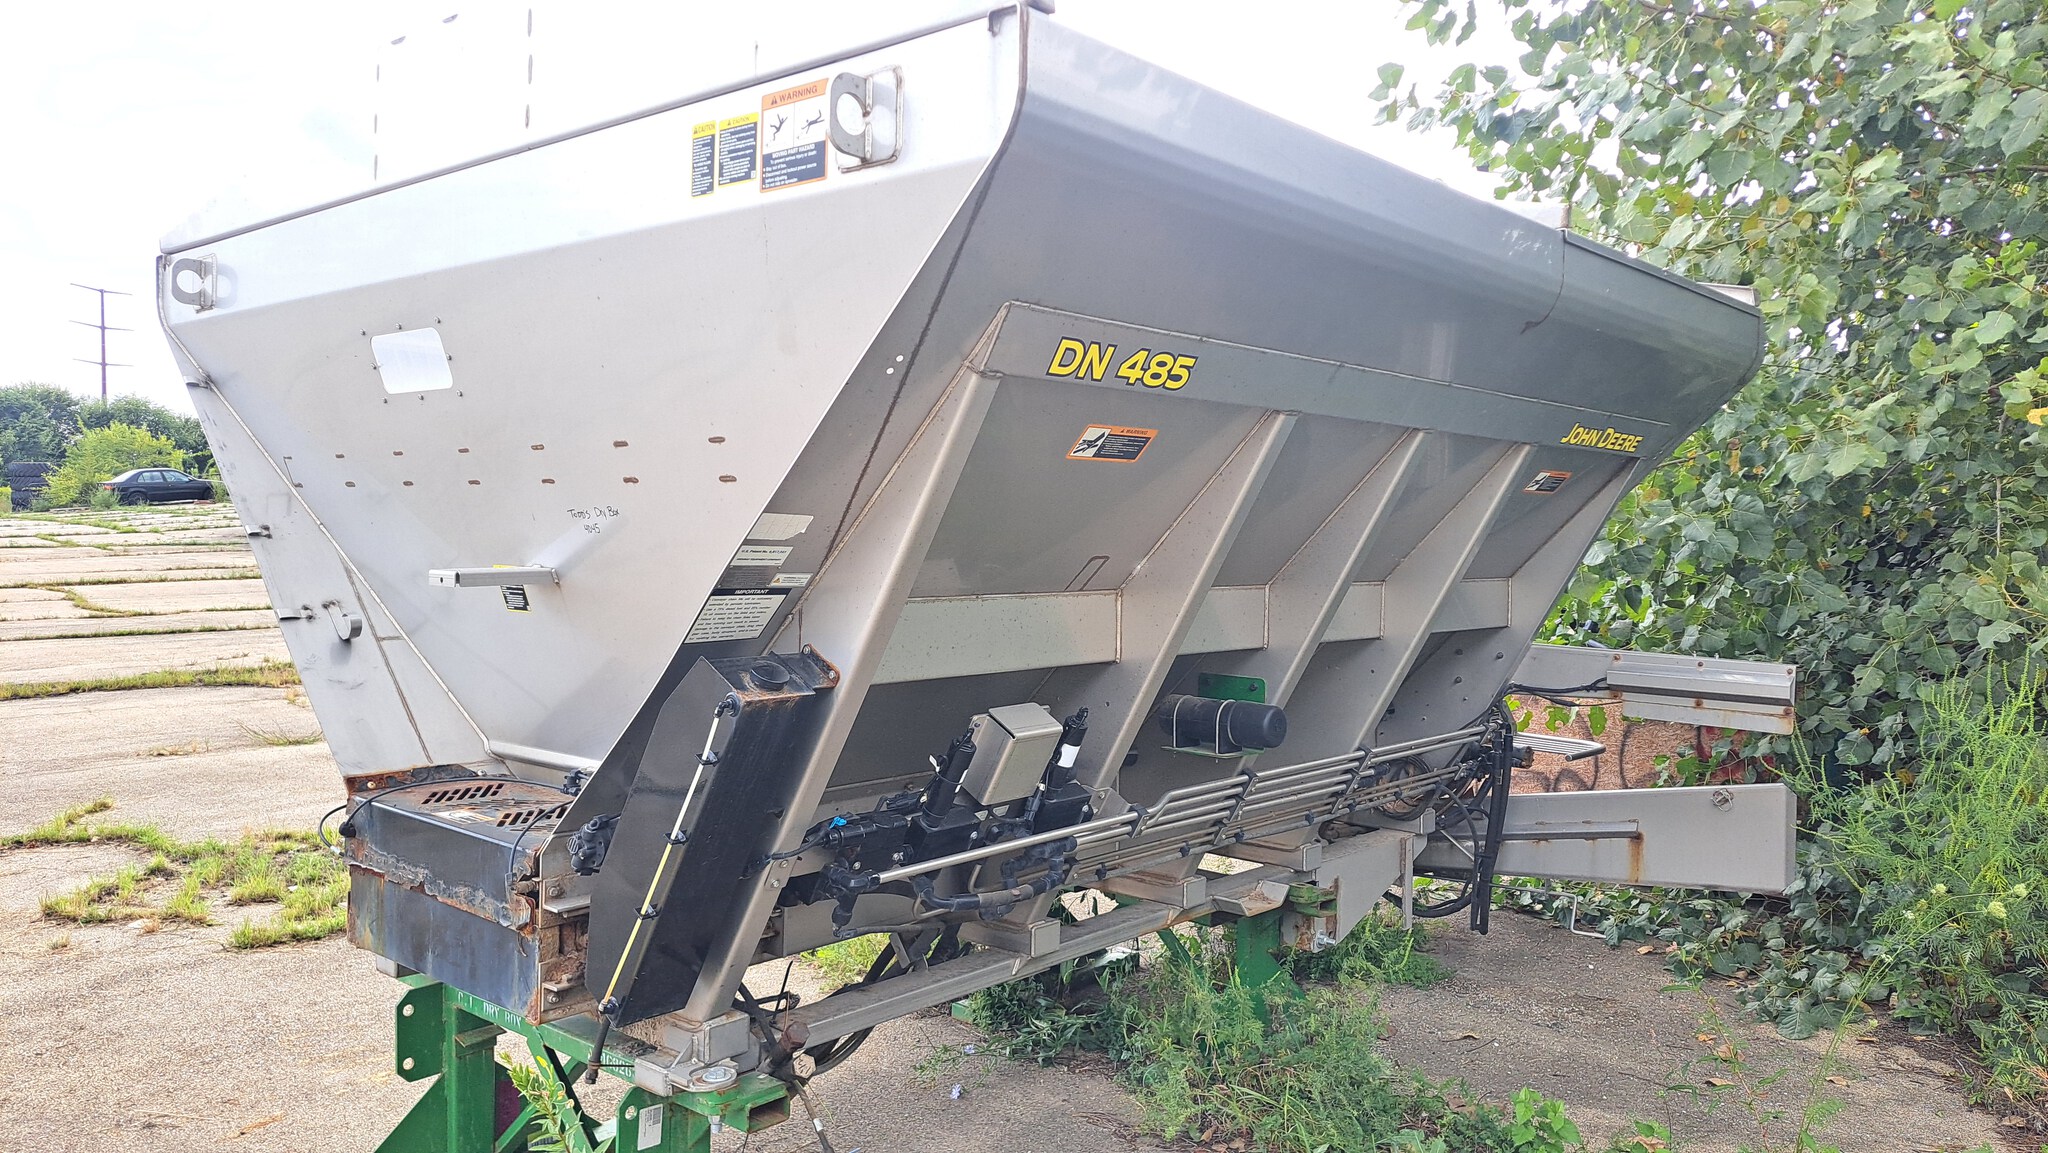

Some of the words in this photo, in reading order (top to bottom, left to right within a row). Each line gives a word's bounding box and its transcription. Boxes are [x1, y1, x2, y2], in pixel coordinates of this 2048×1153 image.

[779, 85, 818, 103] WARNING
[698, 123, 715, 133] CAUTION
[732, 116, 750, 125] CAUTION
[1045, 336, 1118, 382] DN
[1114, 348, 1198, 391] 485
[1560, 422, 1601, 448] JOHN
[1596, 427, 1644, 453] DEERE
[483, 1002, 500, 1020] DRY
[504, 1010, 522, 1029] BOX
